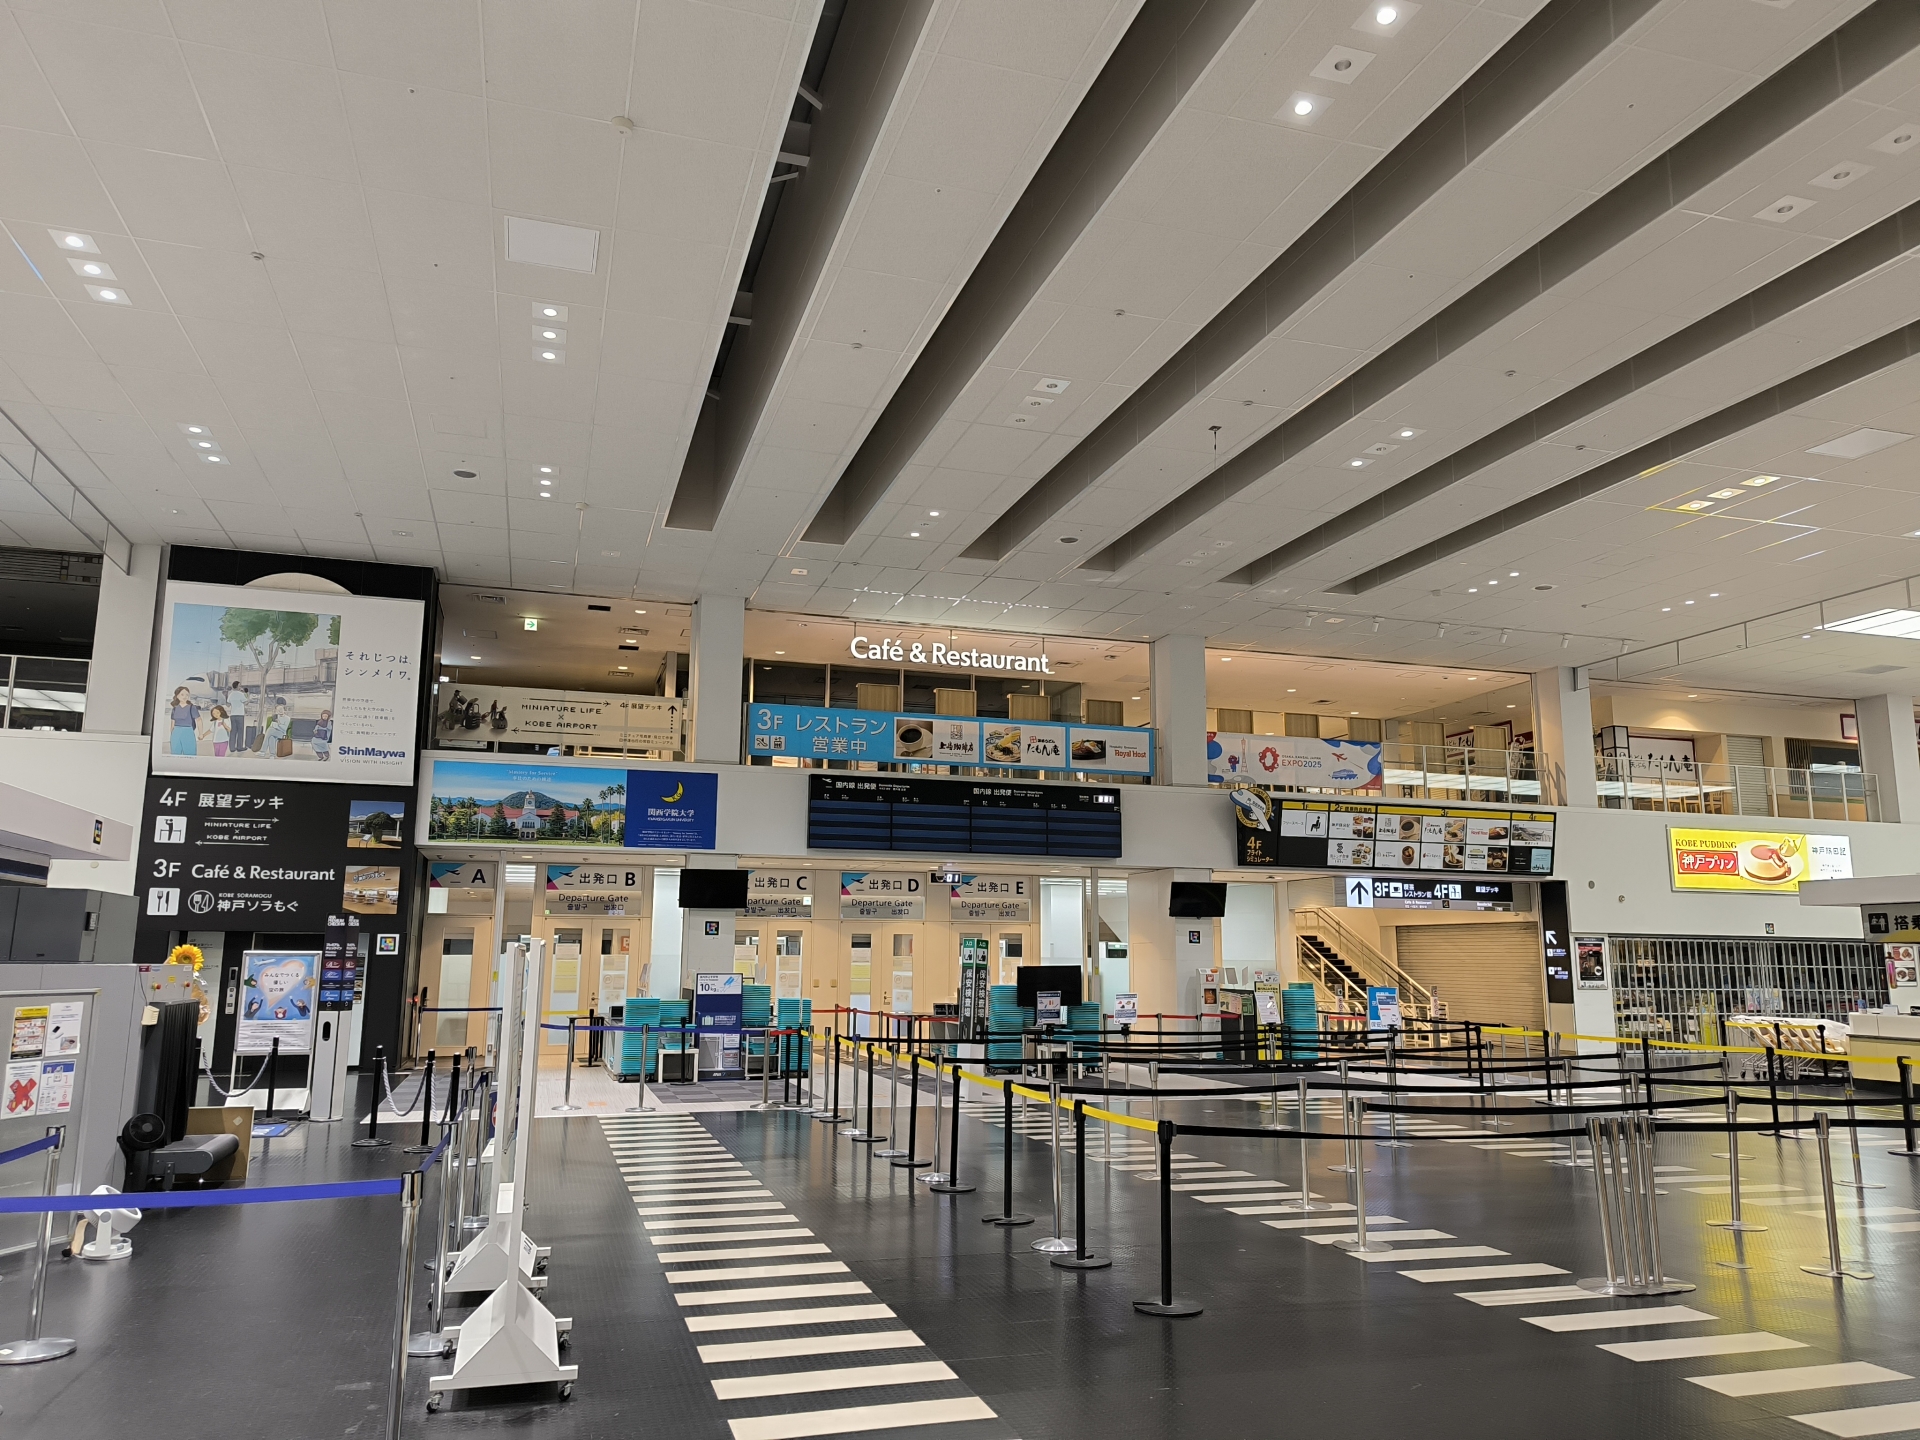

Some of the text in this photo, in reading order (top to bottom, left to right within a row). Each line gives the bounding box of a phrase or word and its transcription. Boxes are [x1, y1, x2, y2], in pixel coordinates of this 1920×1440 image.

[345, 651, 412, 665] それじつは、
[850, 637, 1050, 674] Café & Restaurant
[344, 667, 411, 681] シンメイワ。
[521, 704, 603, 715] MINIATURE LIFE
[525, 720, 598, 730] KOBE AIRPORT
[757, 709, 887, 736] 3F レストラン
[812, 736, 868, 755] 営業中
[338, 746, 406, 759] ShinMaywa
[1115, 749, 1147, 758] Royal Host
[340, 756, 361, 764] VISION
[1281, 759, 1322, 768] EXPO2025
[159, 788, 285, 810] 4F 展望デッキ
[1441, 808, 1450, 817] 3F
[1528, 813, 1537, 821] 4F
[1246, 836, 1262, 849] 4F
[1675, 839, 1737, 849] KOBE PUDDING
[1681, 853, 1735, 870] 神戸プリン
[152, 859, 182, 878] 3F
[191, 864, 230, 879] Café
[233, 867, 247, 879] &
[249, 866, 335, 881] Restaurant
[470, 868, 487, 884] A
[578, 872, 636, 887] 出発口 B
[754, 876, 808, 891] 出発口 C
[868, 878, 919, 892] 出発口 D
[977, 881, 1024, 894] 出発口 E
[1374, 882, 1389, 897] 3F
[1433, 884, 1448, 899] 4F
[558, 893, 629, 903] Departure Gate
[747, 897, 801, 906] parture Gate
[851, 899, 913, 908] Departure Gate
[216, 900, 299, 912] 神戸ソラもぐ
[960, 901, 1020, 910] Departure Gate
[700, 983, 710, 992] 10
[964, 968, 973, 1017] 保安検査場
